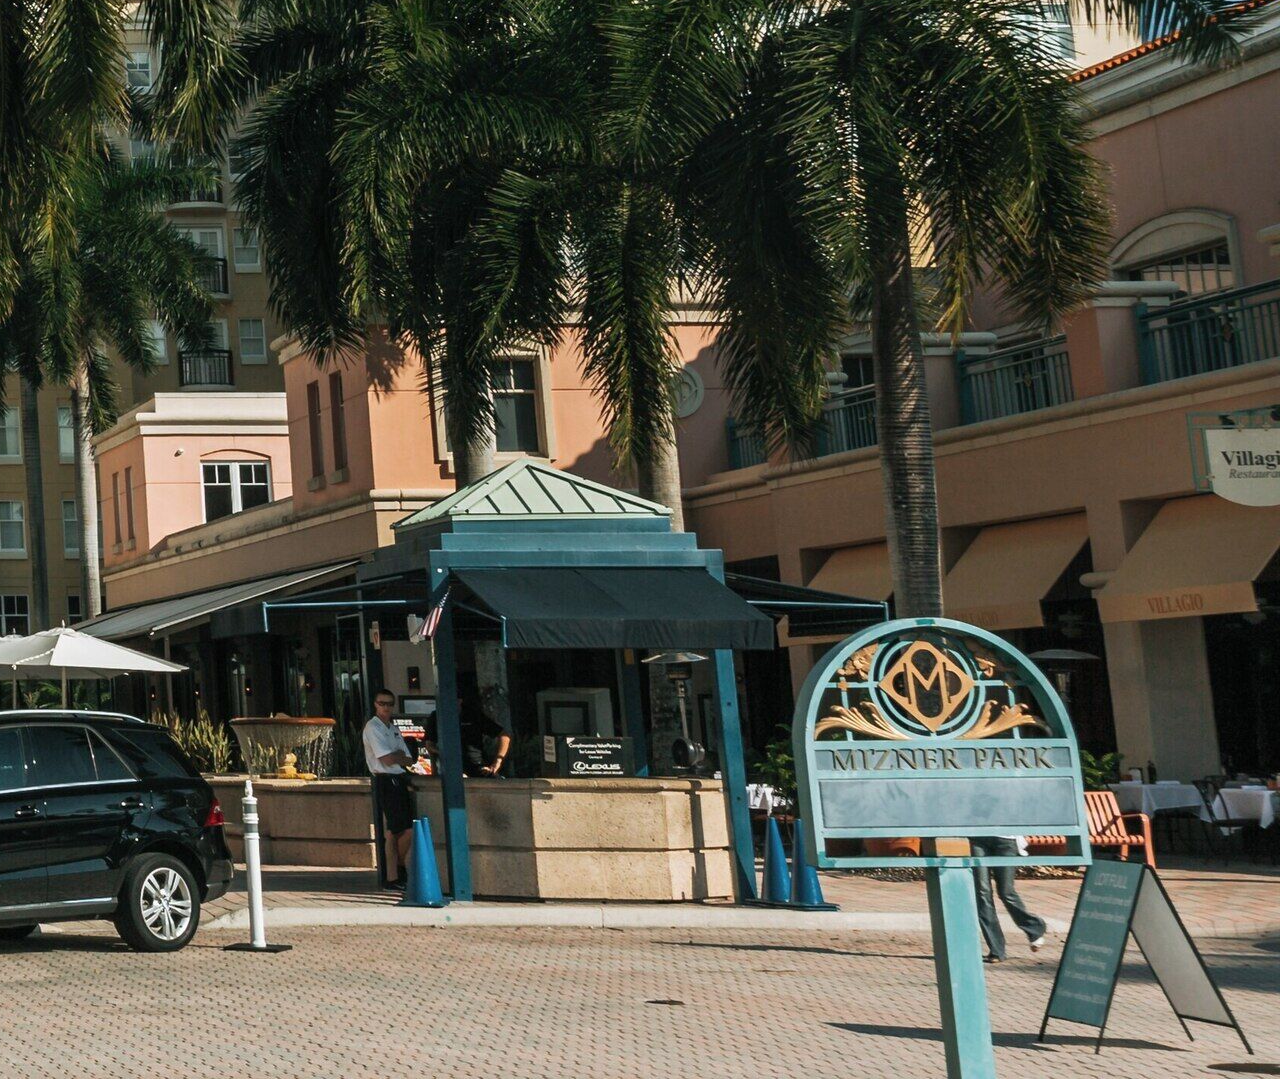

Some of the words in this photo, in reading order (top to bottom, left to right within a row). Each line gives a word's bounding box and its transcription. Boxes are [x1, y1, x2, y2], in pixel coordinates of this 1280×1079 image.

[1221, 450, 1280, 470] Villagi
[1146, 593, 1203, 614] VILLAGIO
[830, 747, 962, 771] MIZNER
[972, 746, 1054, 770] PARK
